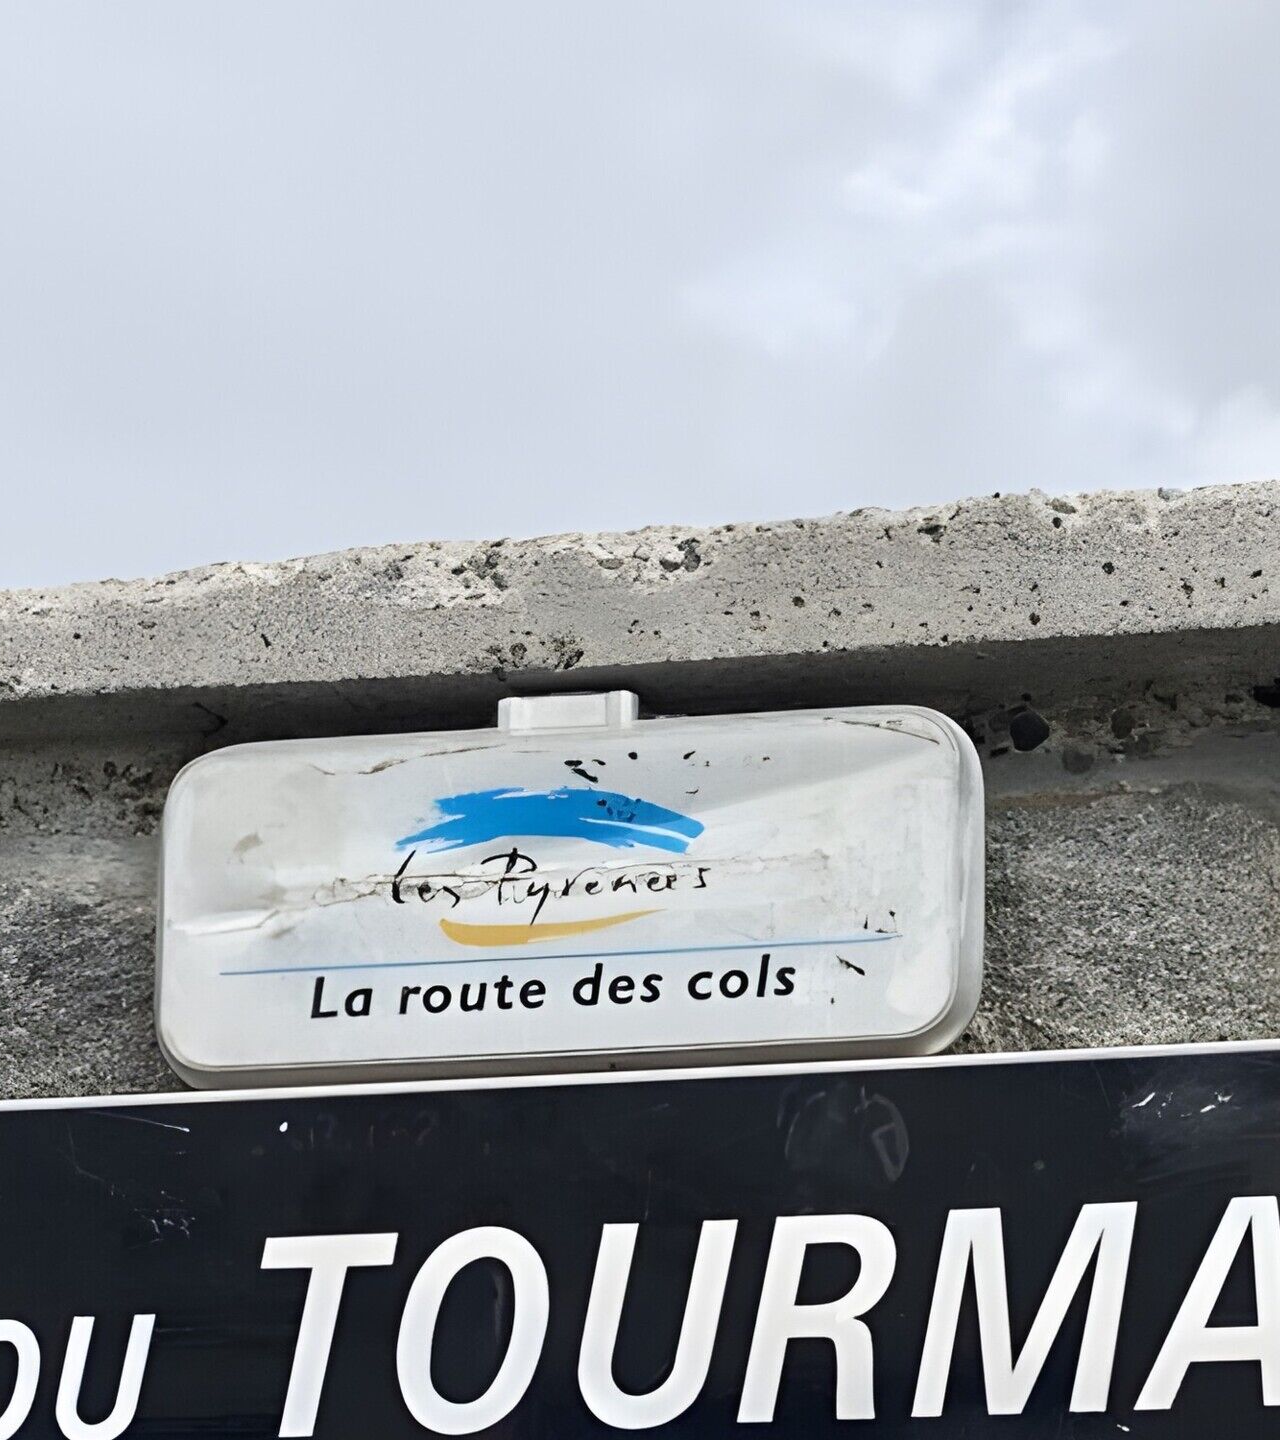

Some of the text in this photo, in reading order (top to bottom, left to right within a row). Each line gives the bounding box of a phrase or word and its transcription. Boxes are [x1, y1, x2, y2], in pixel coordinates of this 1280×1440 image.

[310, 953, 796, 1019] La route des cols
